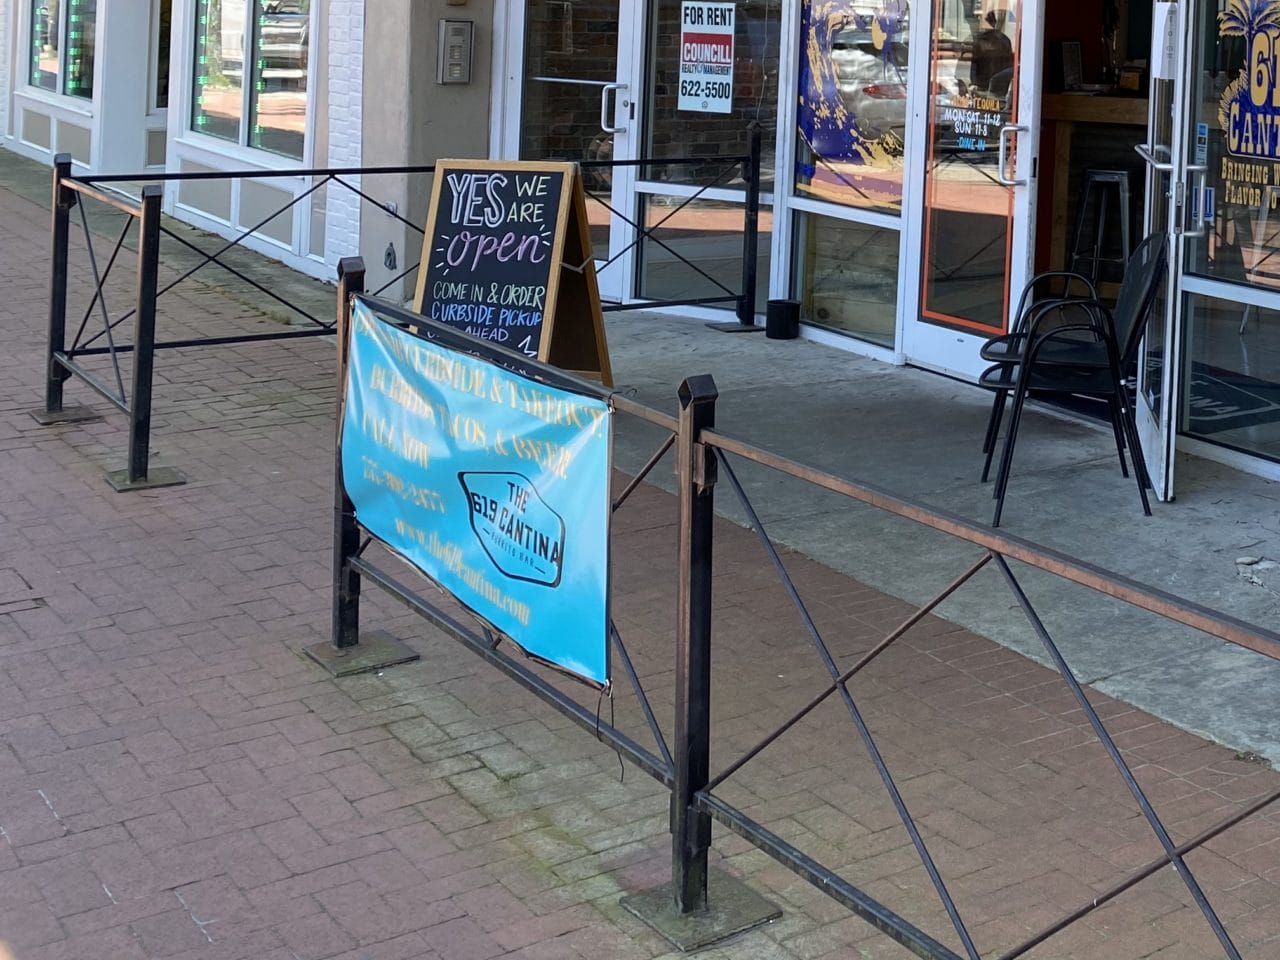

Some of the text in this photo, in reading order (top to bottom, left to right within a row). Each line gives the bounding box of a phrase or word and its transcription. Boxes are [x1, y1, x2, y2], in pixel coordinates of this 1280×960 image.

[683, 6, 733, 26] FOR RENT
[683, 42, 731, 63] COUNCILL
[681, 63, 697, 74] REALTY
[681, 79, 731, 100] 622-5500
[954, 120, 970, 134] SUN
[1221, 157, 1269, 185] BRINGING
[447, 173, 551, 228] YES WE
[1225, 180, 1261, 207] FLAVOR
[507, 202, 545, 223] ARE
[447, 231, 546, 272] open
[433, 280, 546, 311] COME IN & ORDER
[431, 301, 543, 327] CURBSIDE PICKUP
[506, 480, 530, 513] THE
[470, 491, 561, 566] 619 CANTINA
